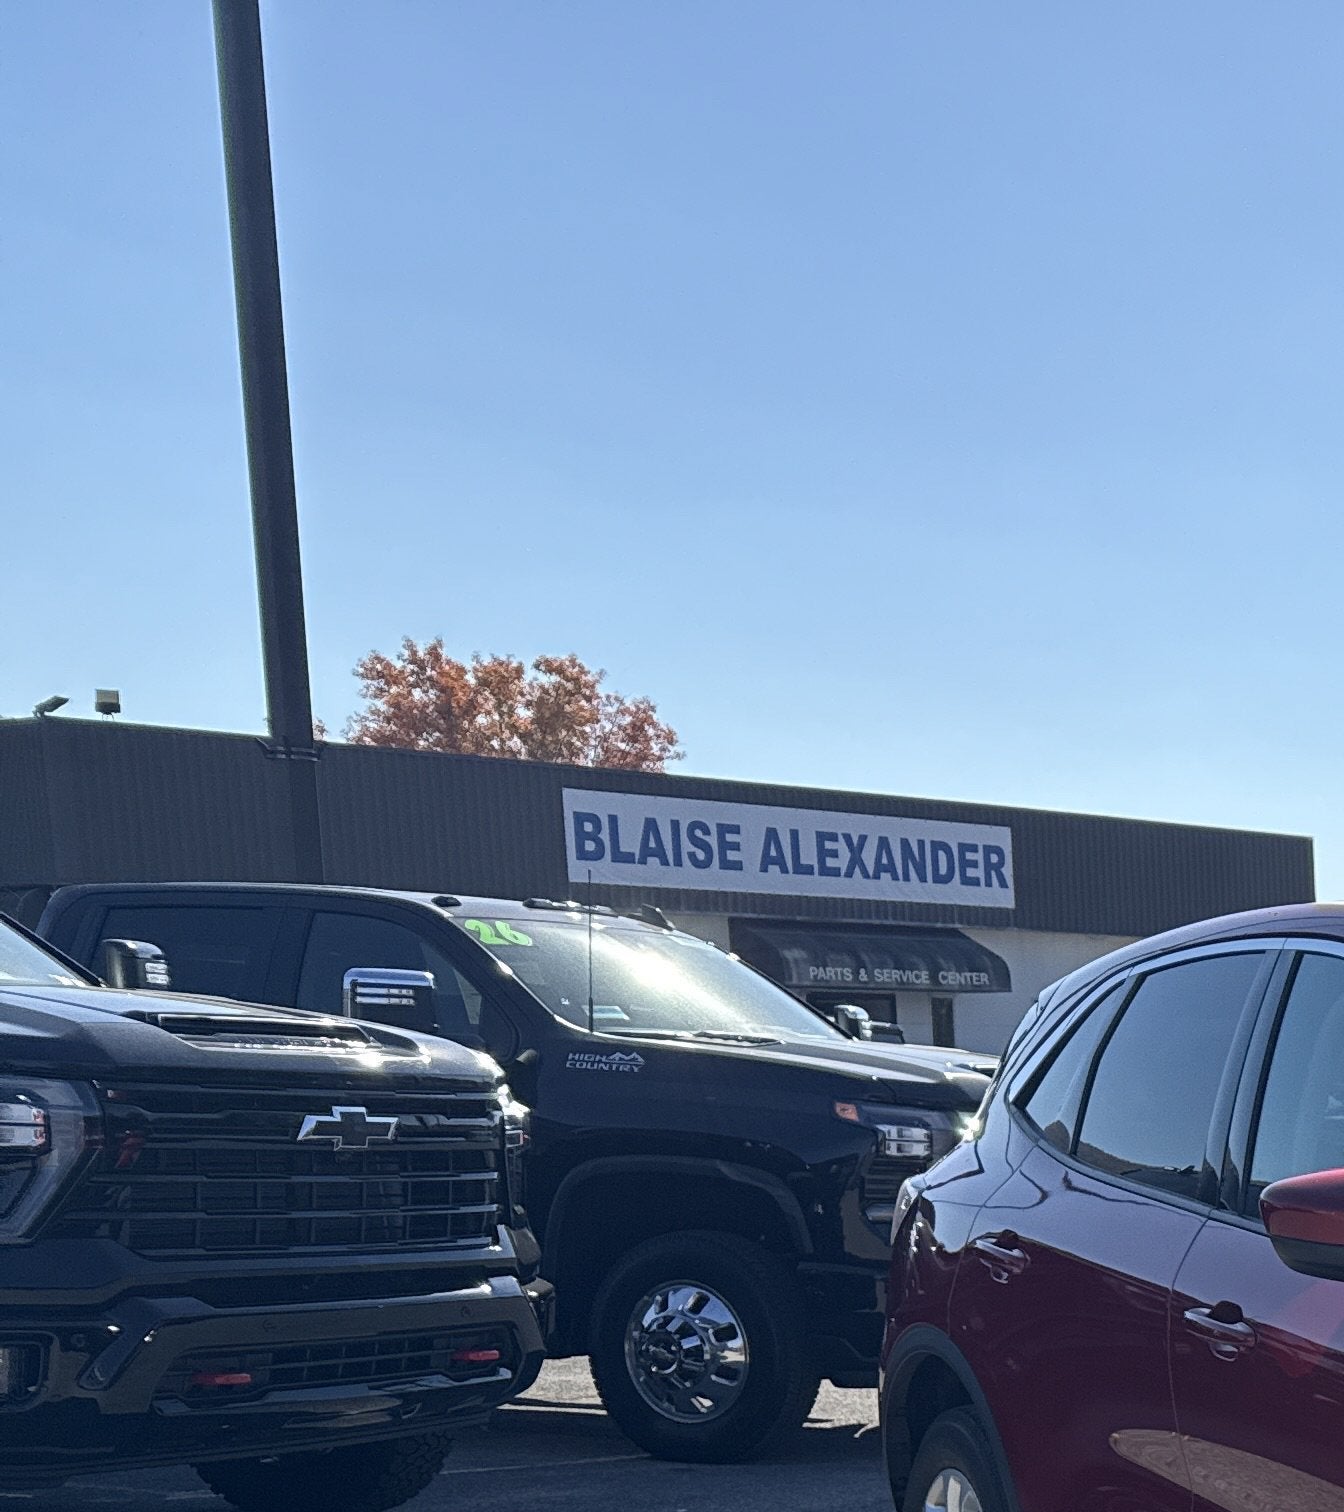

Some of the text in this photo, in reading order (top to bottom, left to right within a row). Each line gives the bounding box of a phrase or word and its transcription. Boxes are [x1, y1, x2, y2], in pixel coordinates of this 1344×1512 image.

[572, 810, 1010, 890] BLAISE ALEXANDER
[464, 919, 534, 947] 26
[809, 966, 990, 986] PARTS & SERVICE CENTER
[566, 1060, 641, 1073] COUNTRY
[568, 1052, 607, 1062] HIGH
